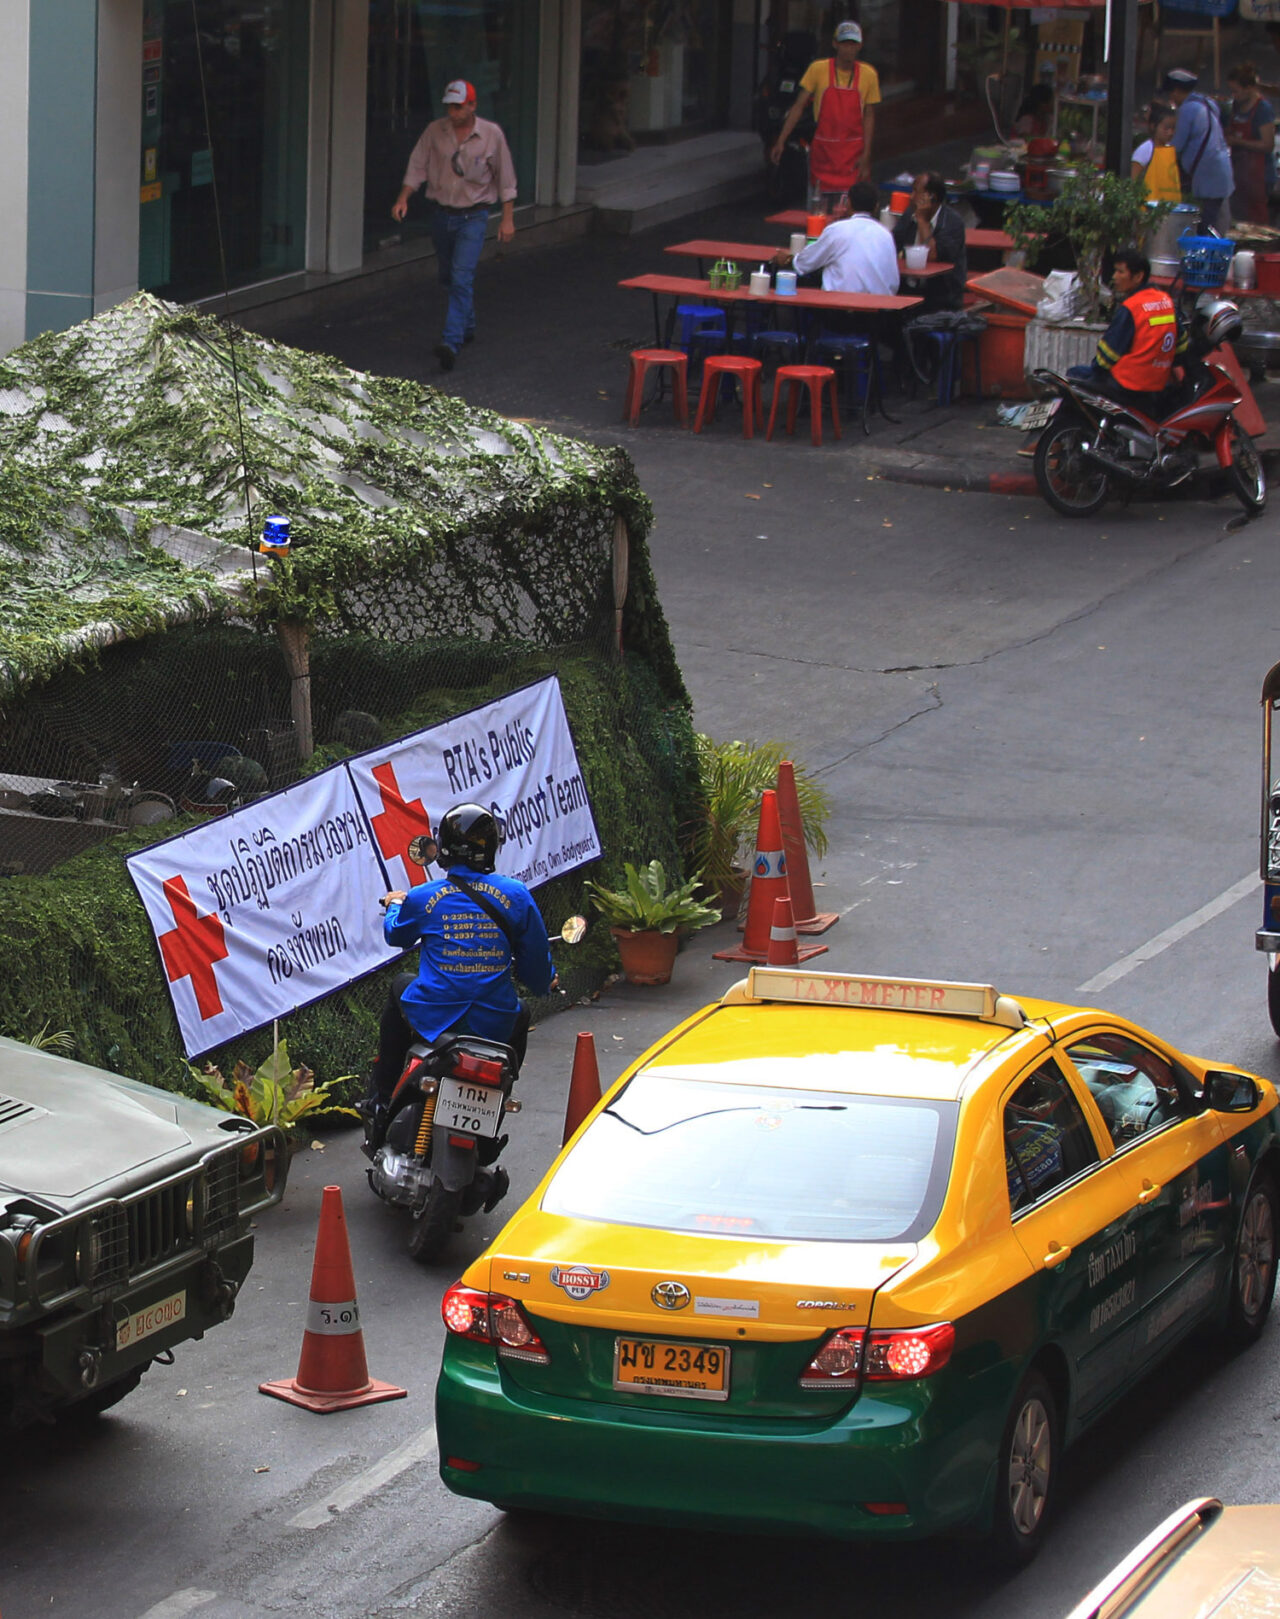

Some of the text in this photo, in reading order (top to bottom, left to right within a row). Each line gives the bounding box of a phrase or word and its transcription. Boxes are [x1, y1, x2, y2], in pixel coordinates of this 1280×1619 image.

[443, 719, 536, 794] RTA's Public
[545, 774, 587, 819] Team
[547, 852, 563, 869] Own
[561, 832, 596, 863] Bodyguard
[267, 911, 348, 985] กองทัพบก
[792, 977, 947, 1010] TAXI-METER
[457, 1086, 488, 1103] 1กม
[452, 1114, 481, 1131] 170
[561, 1273, 597, 1287] BOSSY
[572, 1286, 585, 1294] PUB
[795, 1299, 856, 1311] COROLLA
[664, 1348, 720, 1374] 2349
